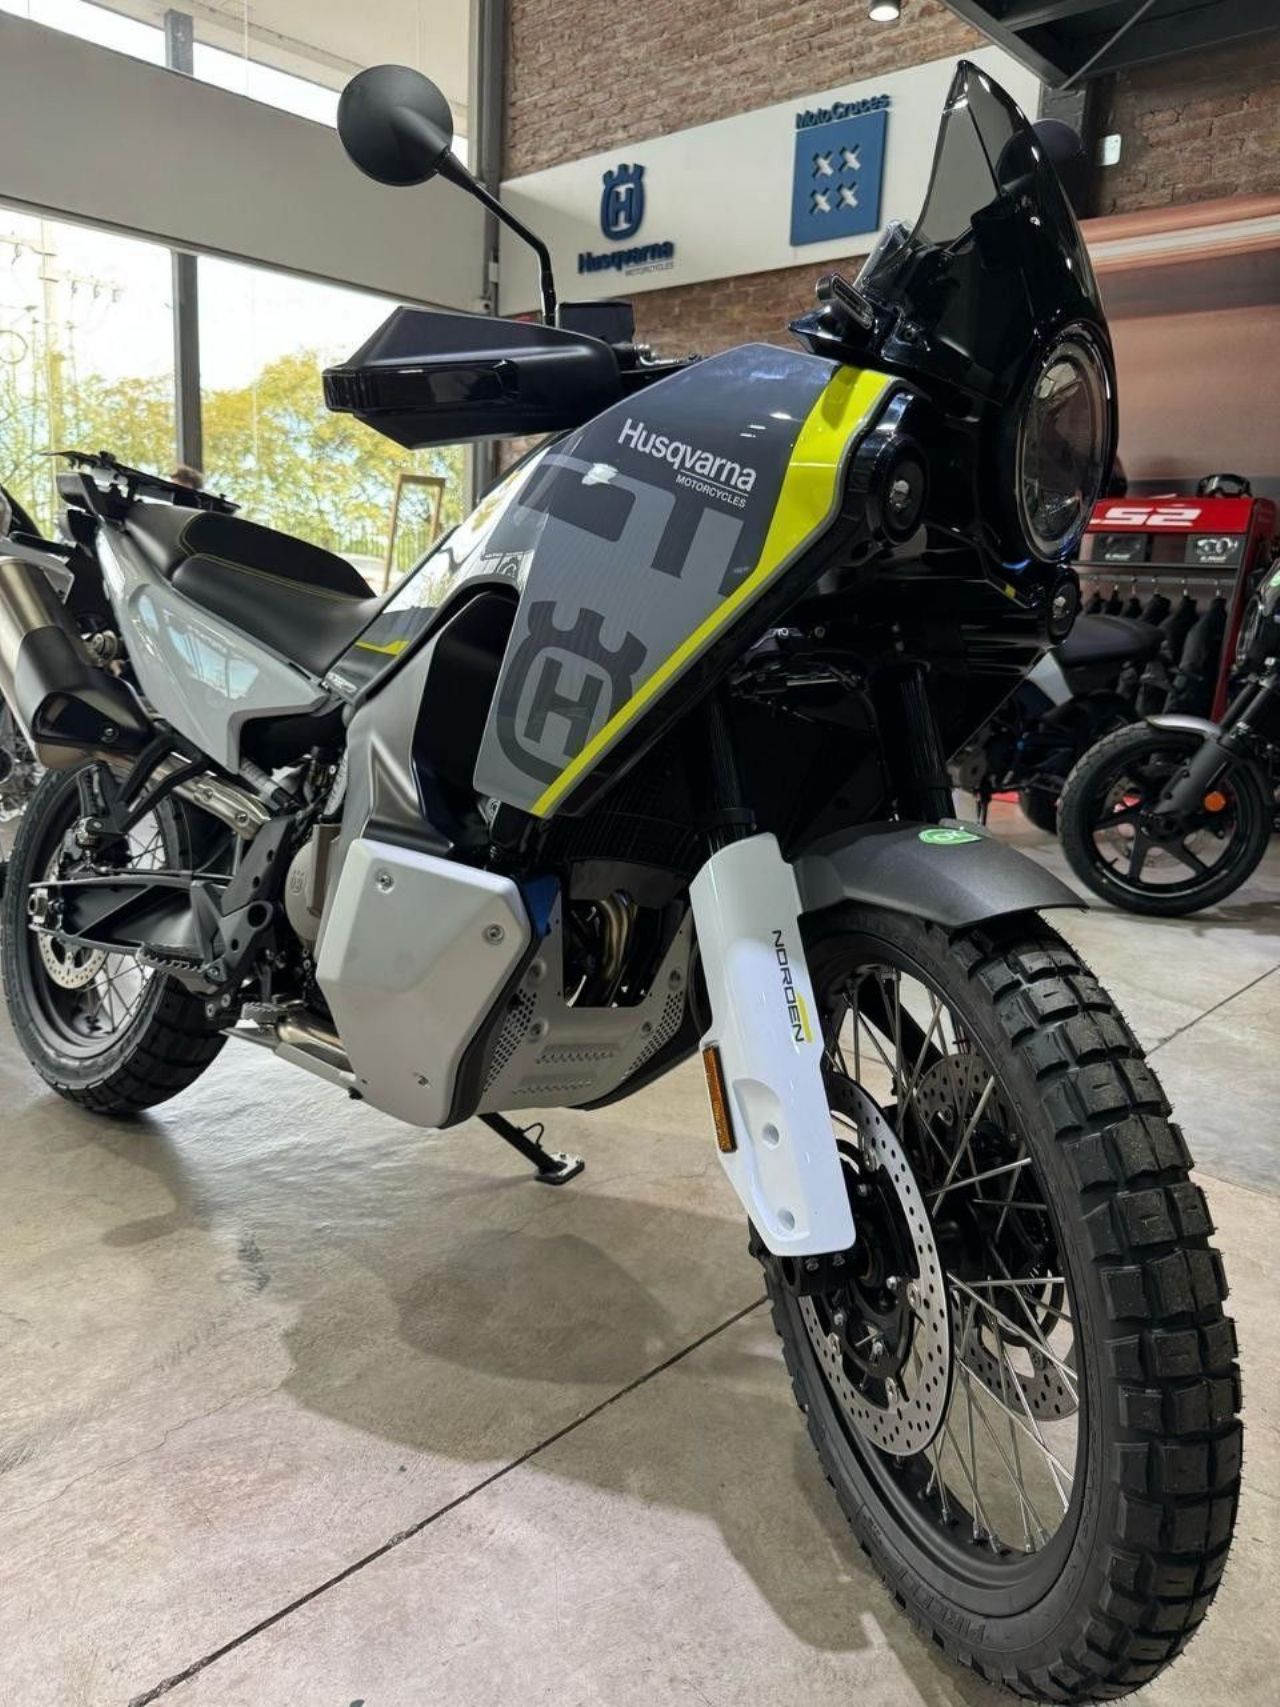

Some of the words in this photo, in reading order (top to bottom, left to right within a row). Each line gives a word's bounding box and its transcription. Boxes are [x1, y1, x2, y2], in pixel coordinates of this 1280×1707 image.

[796, 93, 890, 129] MotoCruces
[578, 241, 674, 274] Husqvarna
[617, 417, 757, 492] Husqvarna
[675, 474, 746, 508] MOTORCYCLES
[771, 929, 805, 1042] NORDEN
